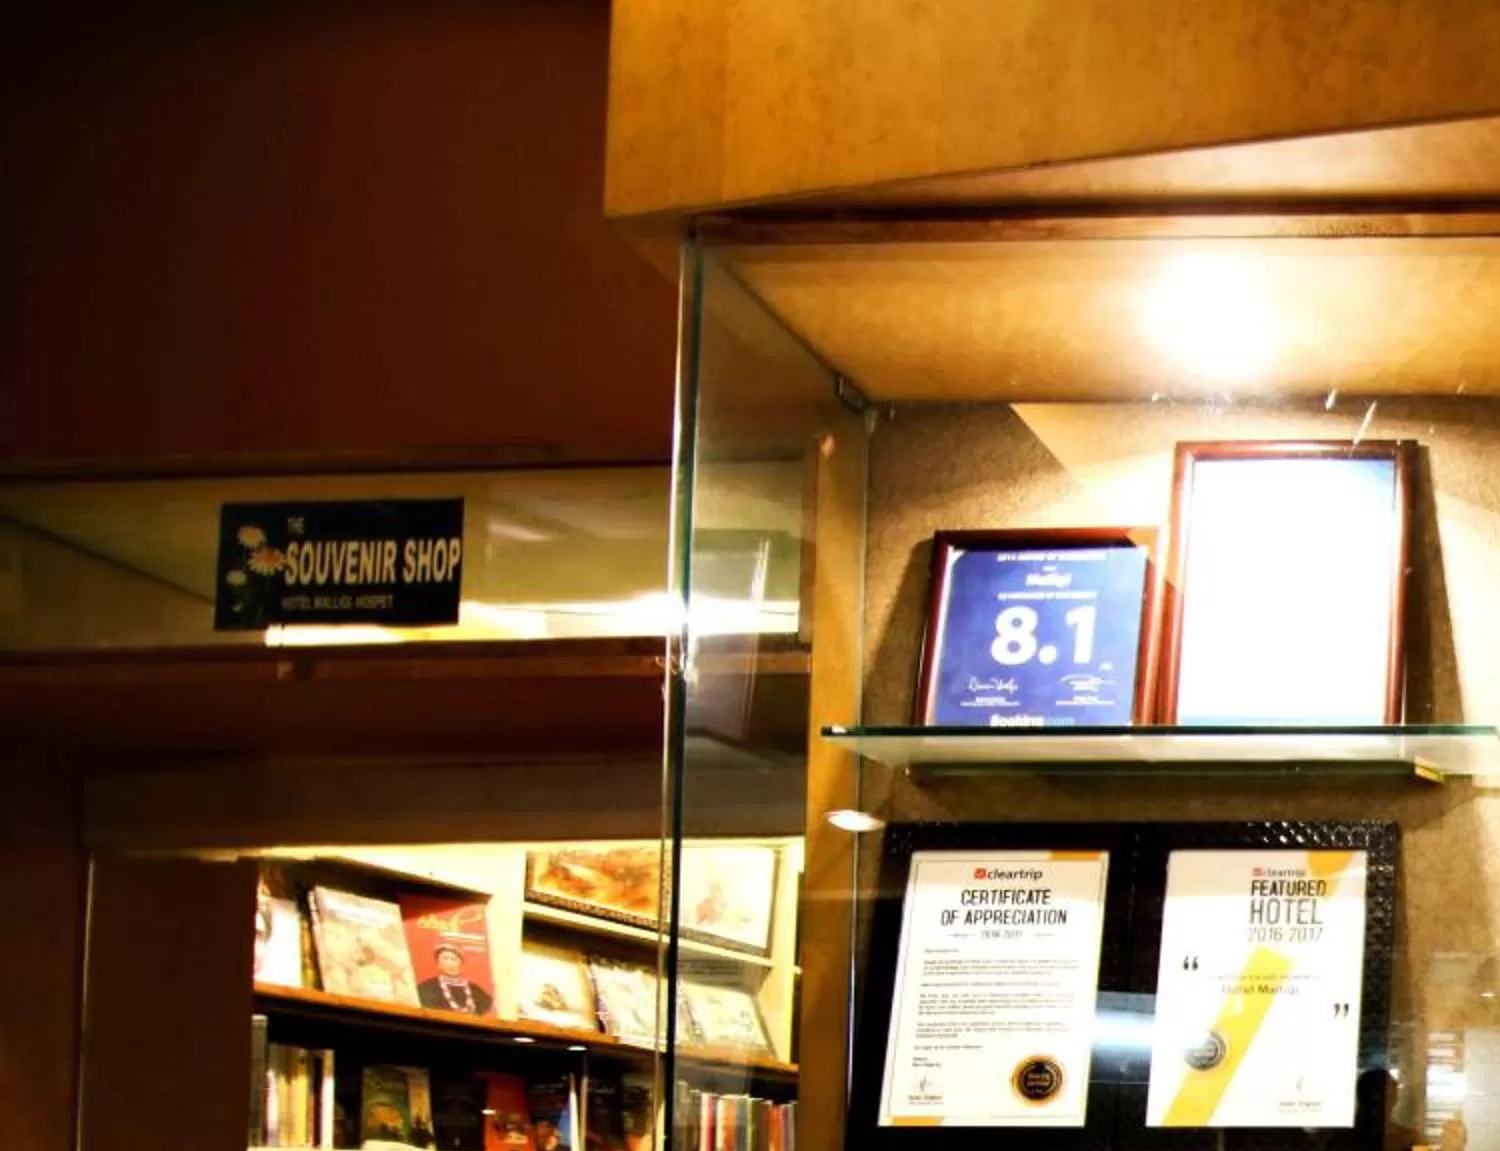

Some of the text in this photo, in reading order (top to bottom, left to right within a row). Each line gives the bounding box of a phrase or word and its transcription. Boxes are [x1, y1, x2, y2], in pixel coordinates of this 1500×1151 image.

[284, 537, 461, 585] SOUVENIR SHOP
[990, 605, 1097, 665] 8.1
[987, 868, 1043, 881] cleartrip
[960, 889, 1052, 906] CERTIFICATE
[1250, 880, 1327, 897] FEATURED
[940, 908, 1068, 926] OF APPRECIATION
[1248, 899, 1324, 925] HOTEL
